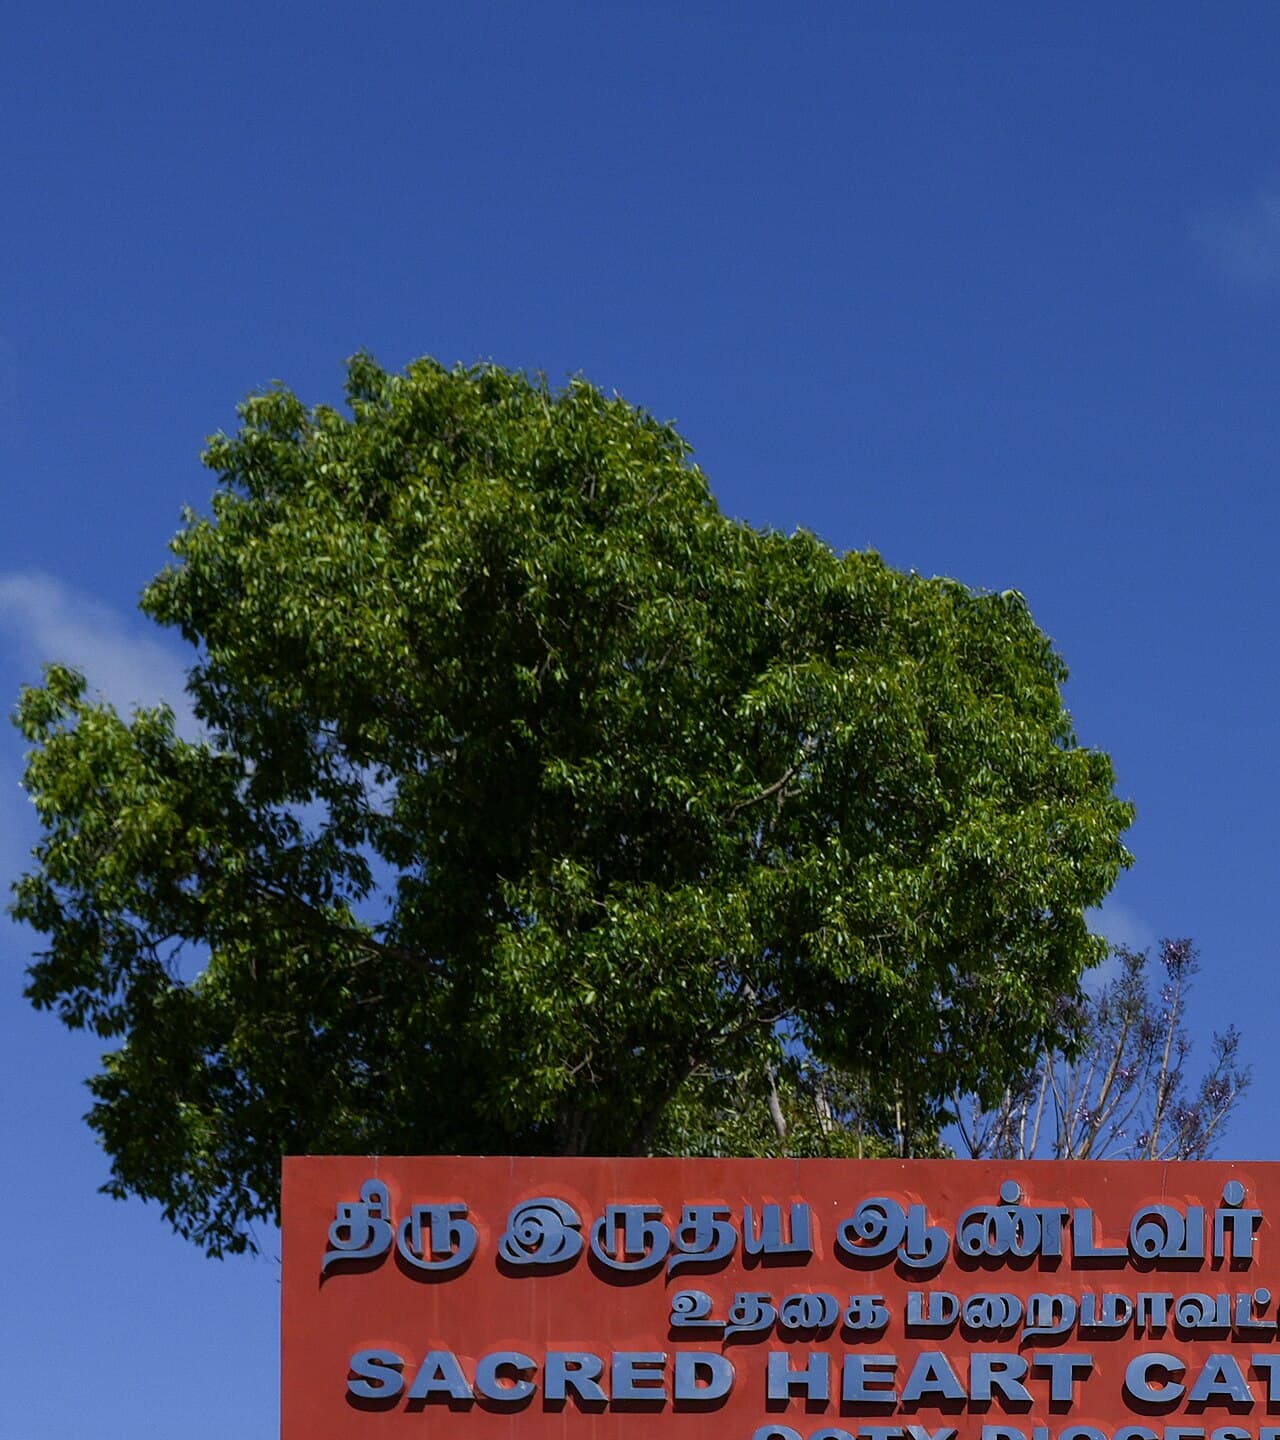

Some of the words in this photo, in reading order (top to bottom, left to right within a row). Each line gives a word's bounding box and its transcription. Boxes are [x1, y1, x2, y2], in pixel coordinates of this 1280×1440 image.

[321, 1179, 479, 1273] திரு
[499, 1197, 812, 1274] இருதய
[837, 1180, 1261, 1269] ஆண்டவர்
[671, 1290, 889, 1337] உதகை
[347, 1349, 735, 1402] SACRED
[766, 1350, 1092, 1403] HEART
